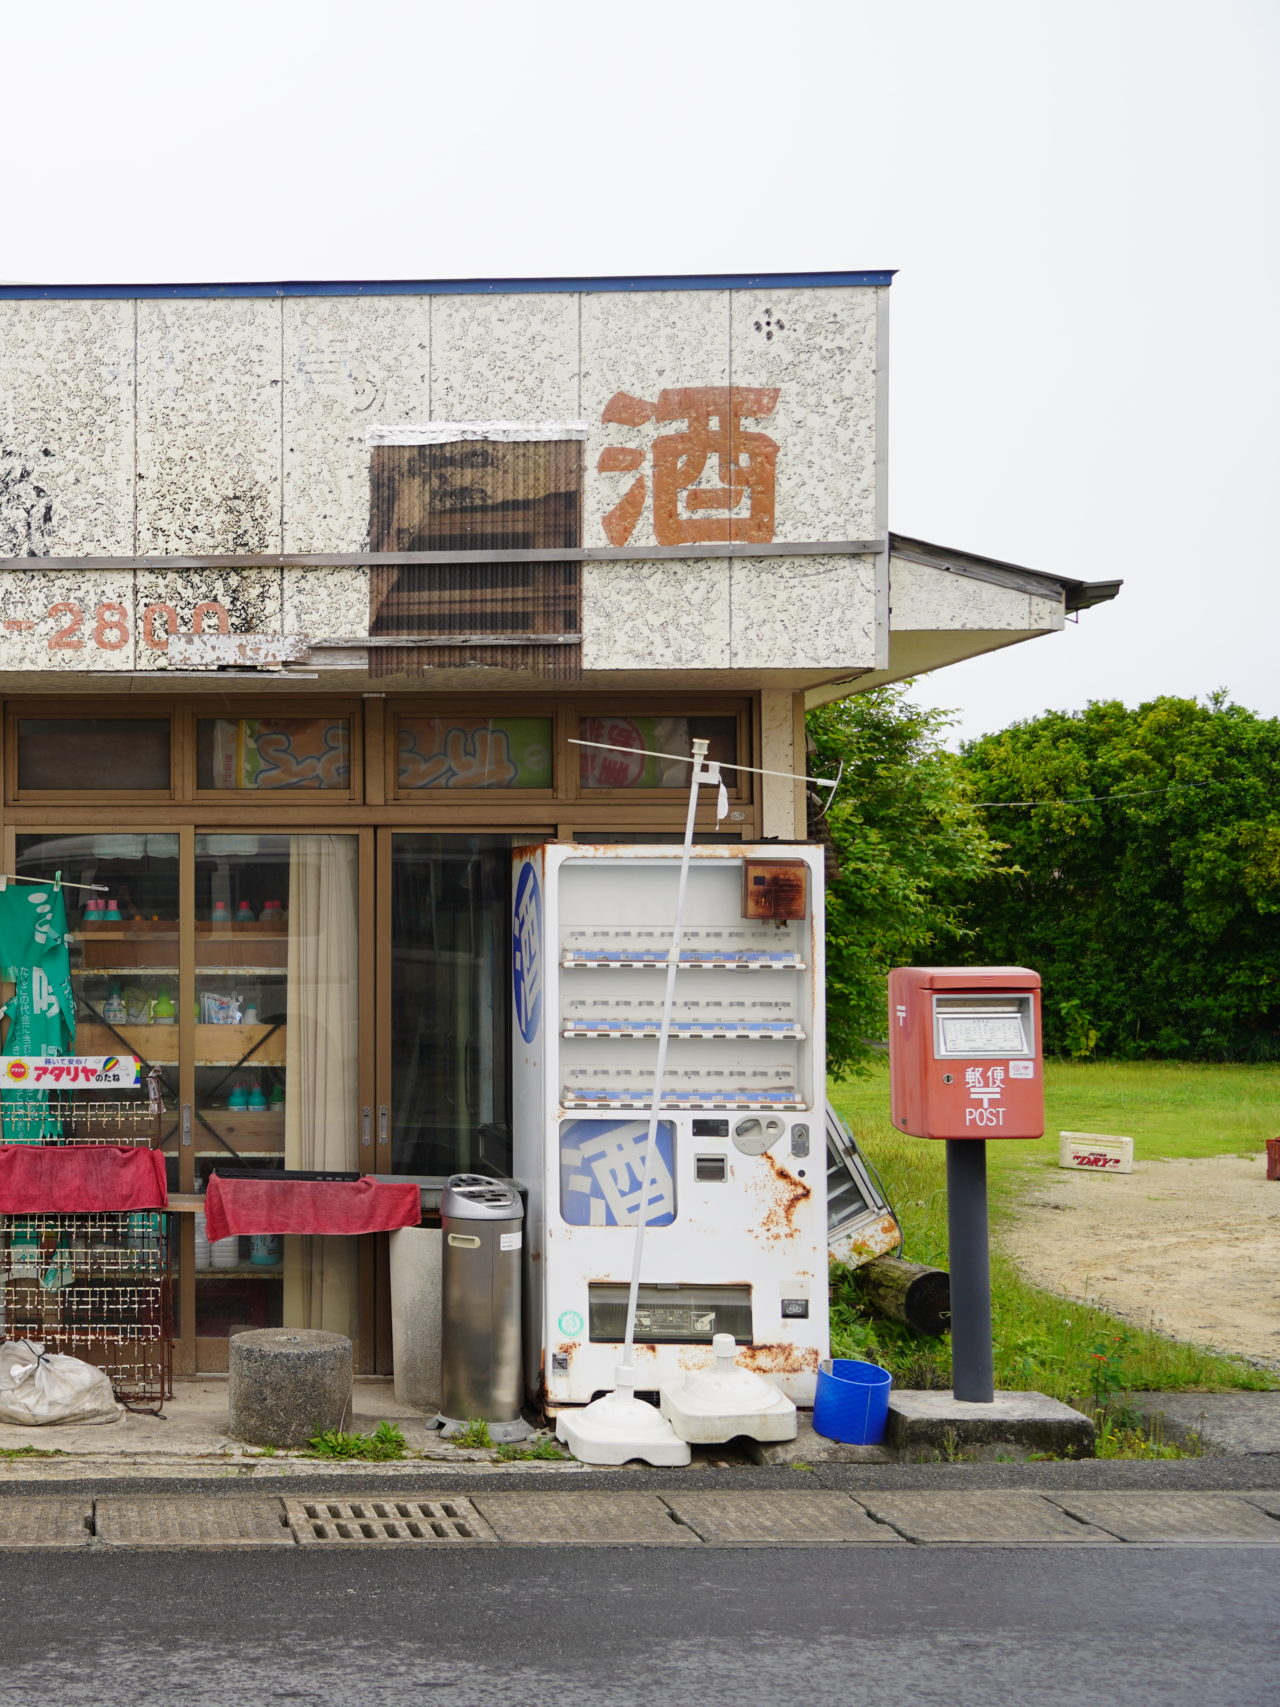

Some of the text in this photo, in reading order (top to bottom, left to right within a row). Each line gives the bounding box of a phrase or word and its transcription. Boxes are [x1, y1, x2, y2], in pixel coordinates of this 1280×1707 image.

[597, 386, 782, 547] 酒
[513, 870, 541, 1036] 酒
[965, 1066, 1005, 1088] 郵便
[966, 1108, 1006, 1126] POST
[560, 1120, 676, 1226] 酒
